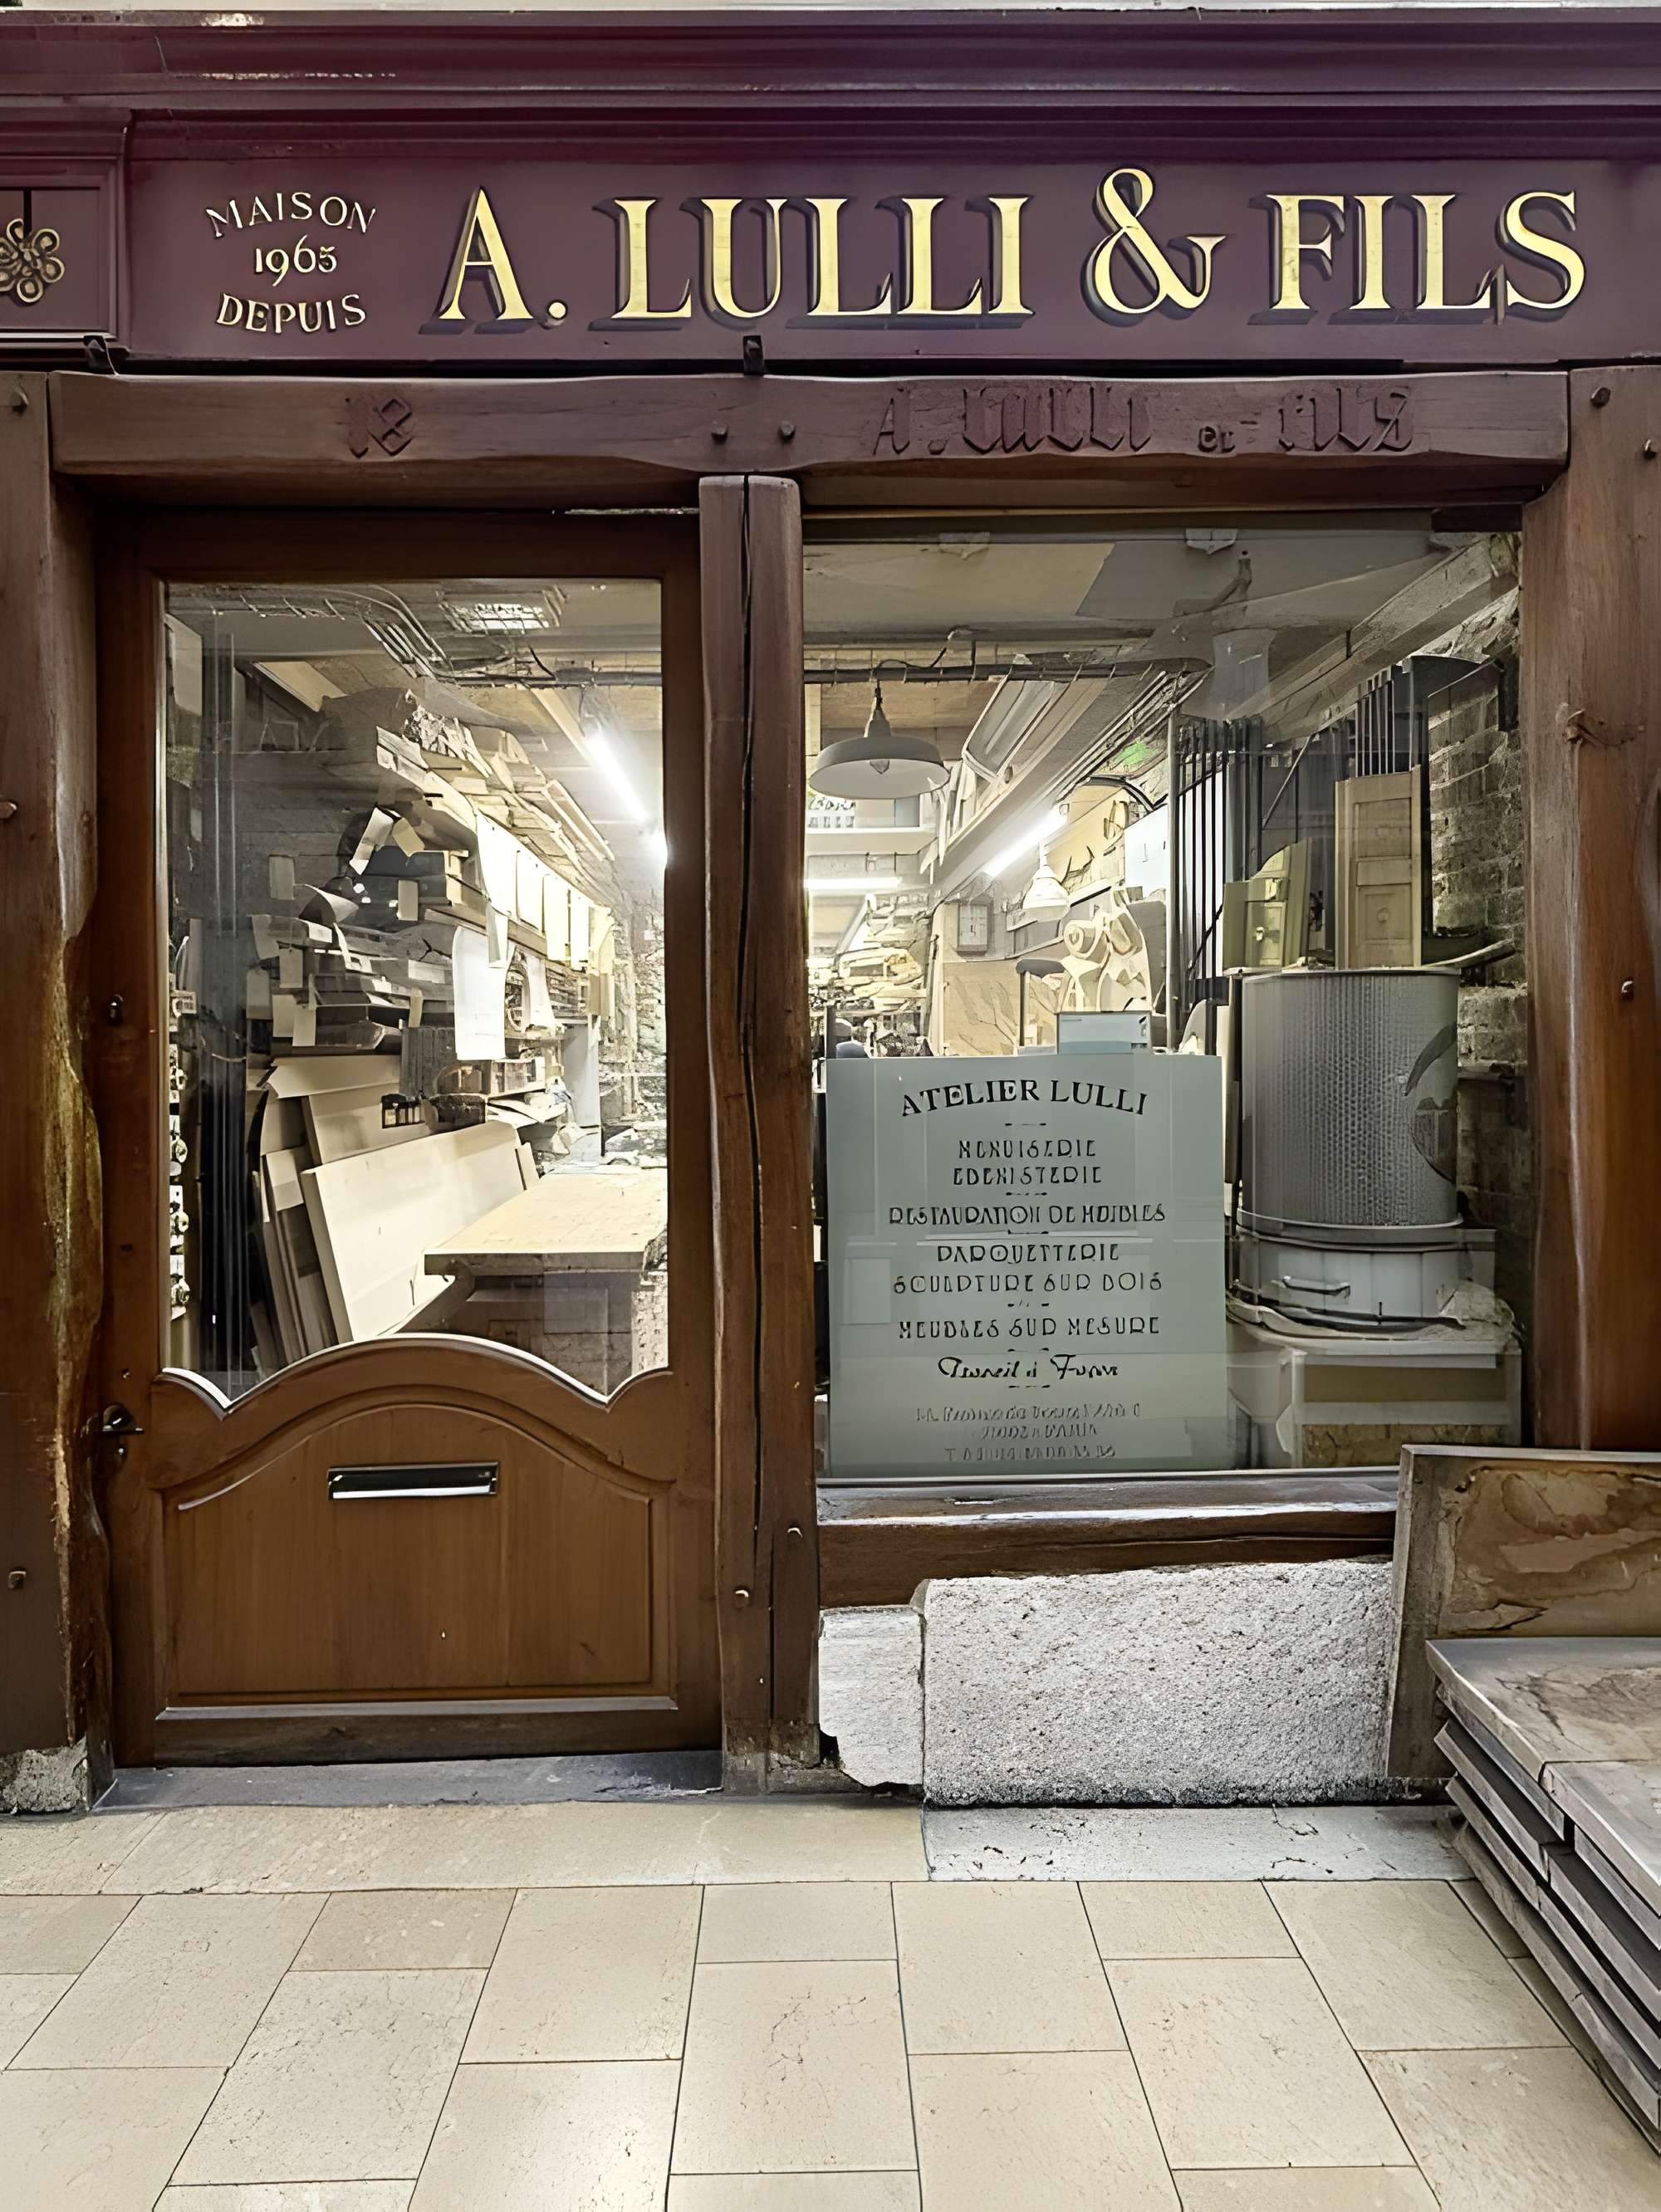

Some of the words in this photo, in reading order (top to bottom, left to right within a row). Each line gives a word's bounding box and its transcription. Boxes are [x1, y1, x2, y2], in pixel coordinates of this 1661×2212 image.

[205, 191, 376, 237] MAISON
[254, 234, 338, 287] 1965
[435, 185, 569, 322] A.
[605, 197, 1036, 321] LULLI
[1090, 166, 1227, 316] &
[1262, 189, 1587, 312] FILS
[215, 293, 367, 334] DEPUIS
[901, 1079, 1040, 1118] ATELIER
[1050, 1079, 1149, 1116] LULLI
